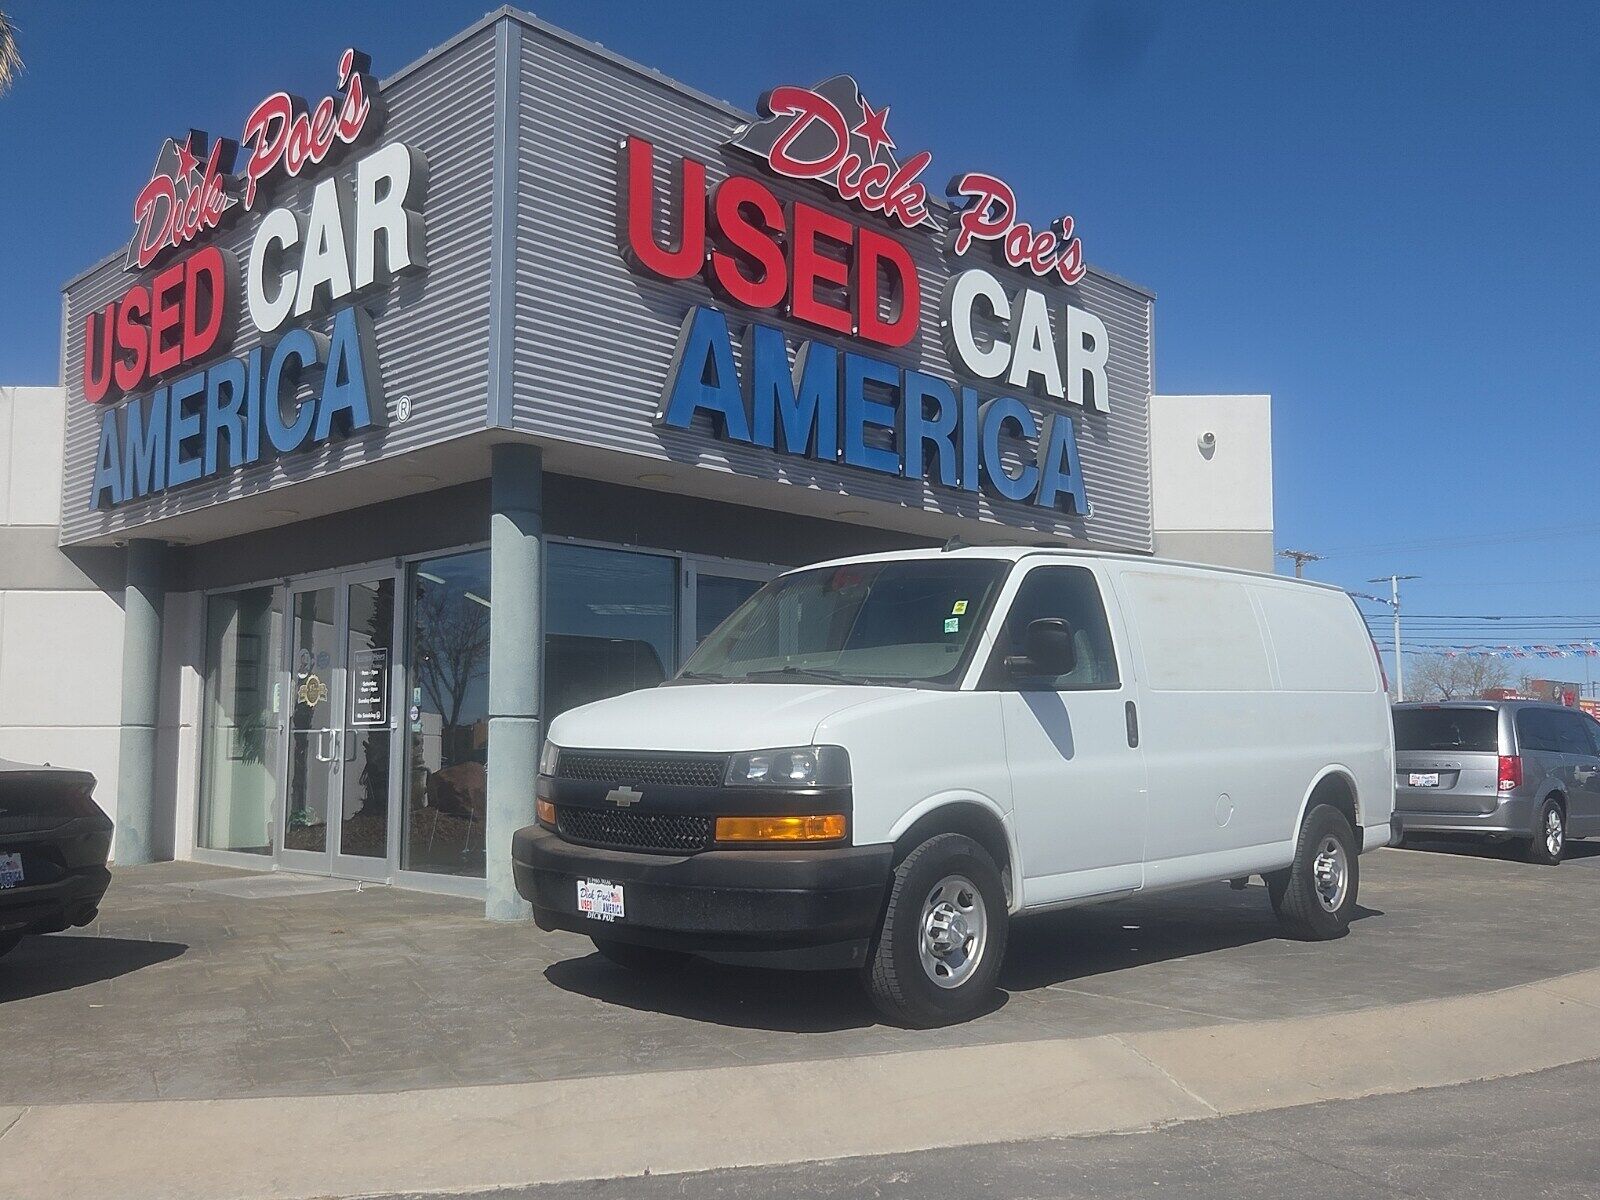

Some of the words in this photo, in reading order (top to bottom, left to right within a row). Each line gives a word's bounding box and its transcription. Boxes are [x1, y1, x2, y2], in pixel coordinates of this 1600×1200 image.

[135, 137, 228, 269] Dick
[243, 47, 370, 211] Poe's
[767, 85, 932, 228] Dick
[954, 172, 1087, 286] Poe's
[83, 245, 226, 404] USED
[247, 142, 411, 333] CAR
[626, 133, 921, 348] USED
[950, 268, 1111, 415] CAR
[88, 306, 371, 511] AMERICA
[664, 306, 1089, 517] AMERICA
